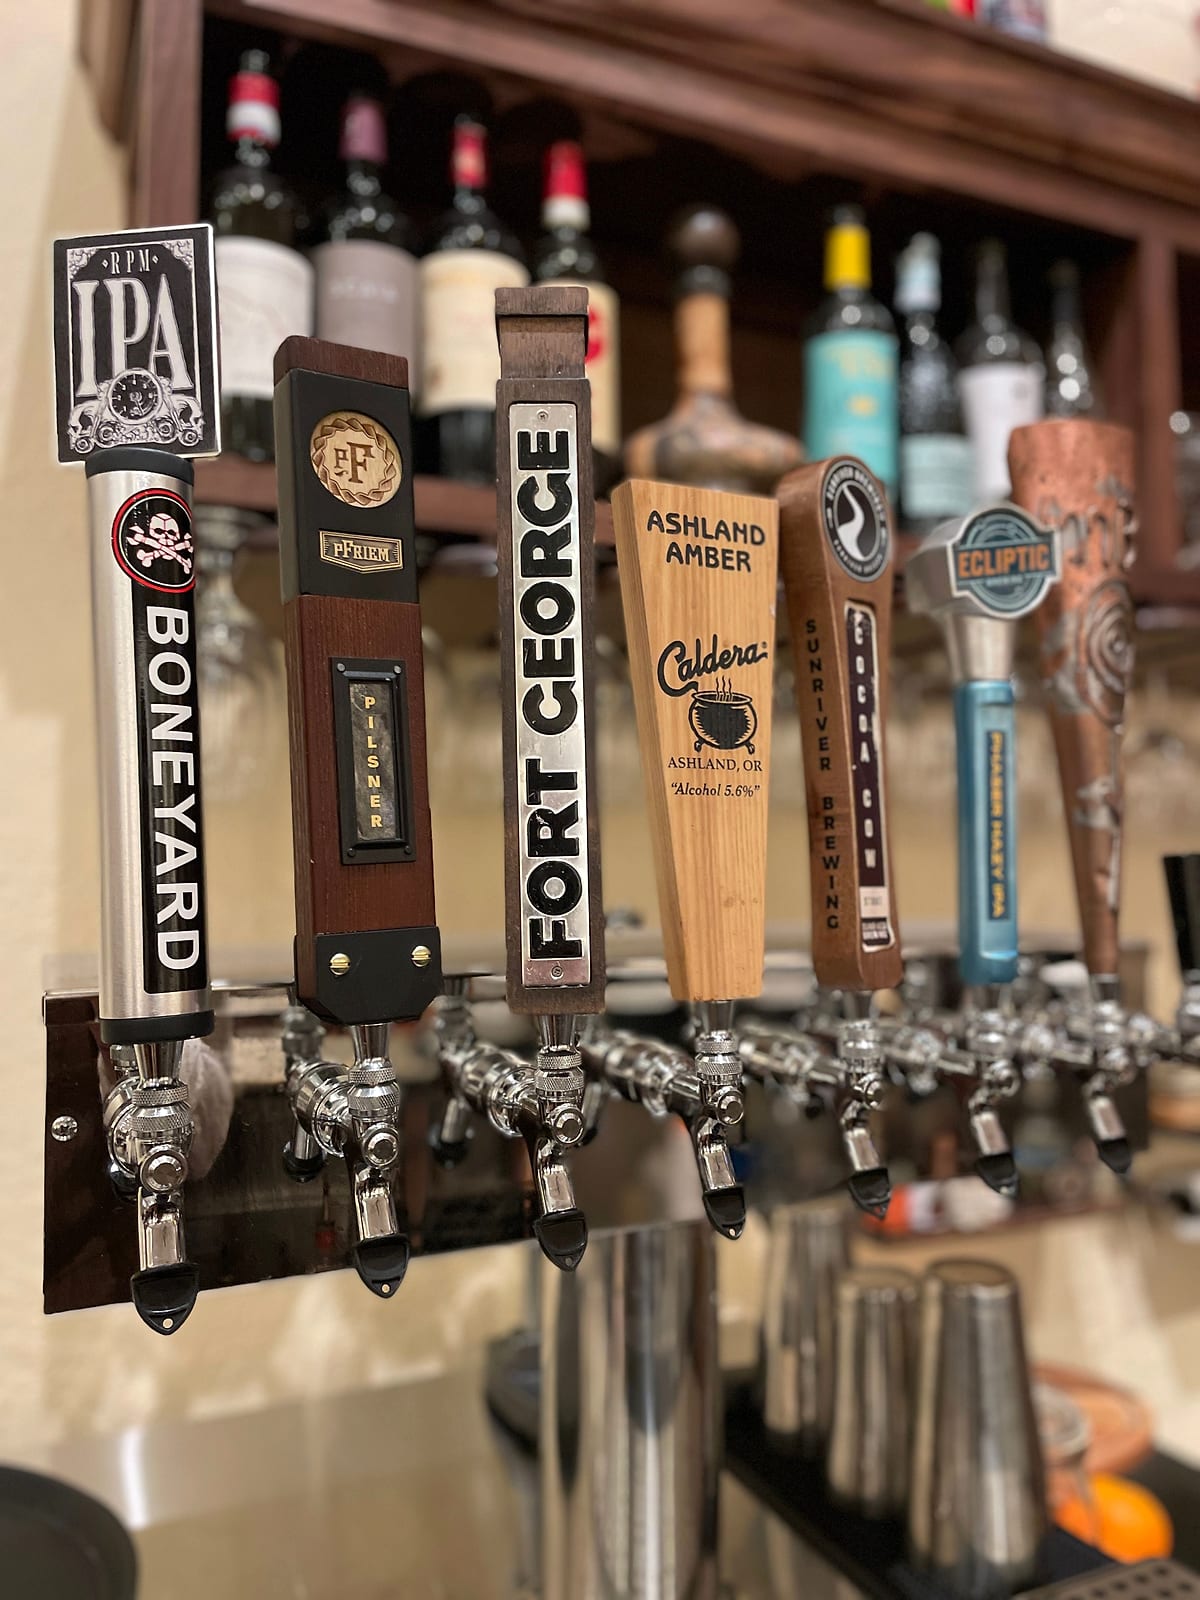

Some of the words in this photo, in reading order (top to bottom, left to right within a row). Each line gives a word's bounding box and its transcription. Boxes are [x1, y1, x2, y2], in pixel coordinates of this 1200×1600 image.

[110, 249, 152, 275] RPM
[72, 273, 194, 398] IPA
[647, 509, 767, 546] ASHLAND
[666, 542, 752, 572] AMBER
[957, 542, 1051, 578] ECLIPTIC
[516, 429, 579, 736] GEORGE
[146, 606, 200, 971] BONEYARD
[364, 696, 383, 828] PILSNER
[667, 756, 740, 773] ASHLAND,
[743, 759, 763, 772] OR
[671, 782, 721, 796] “Alcohol
[724, 784, 760, 798] 5.6%”
[806, 619, 831, 771] SUNRIVER
[822, 796, 840, 930] BREWING
[526, 758, 583, 959] FORT
